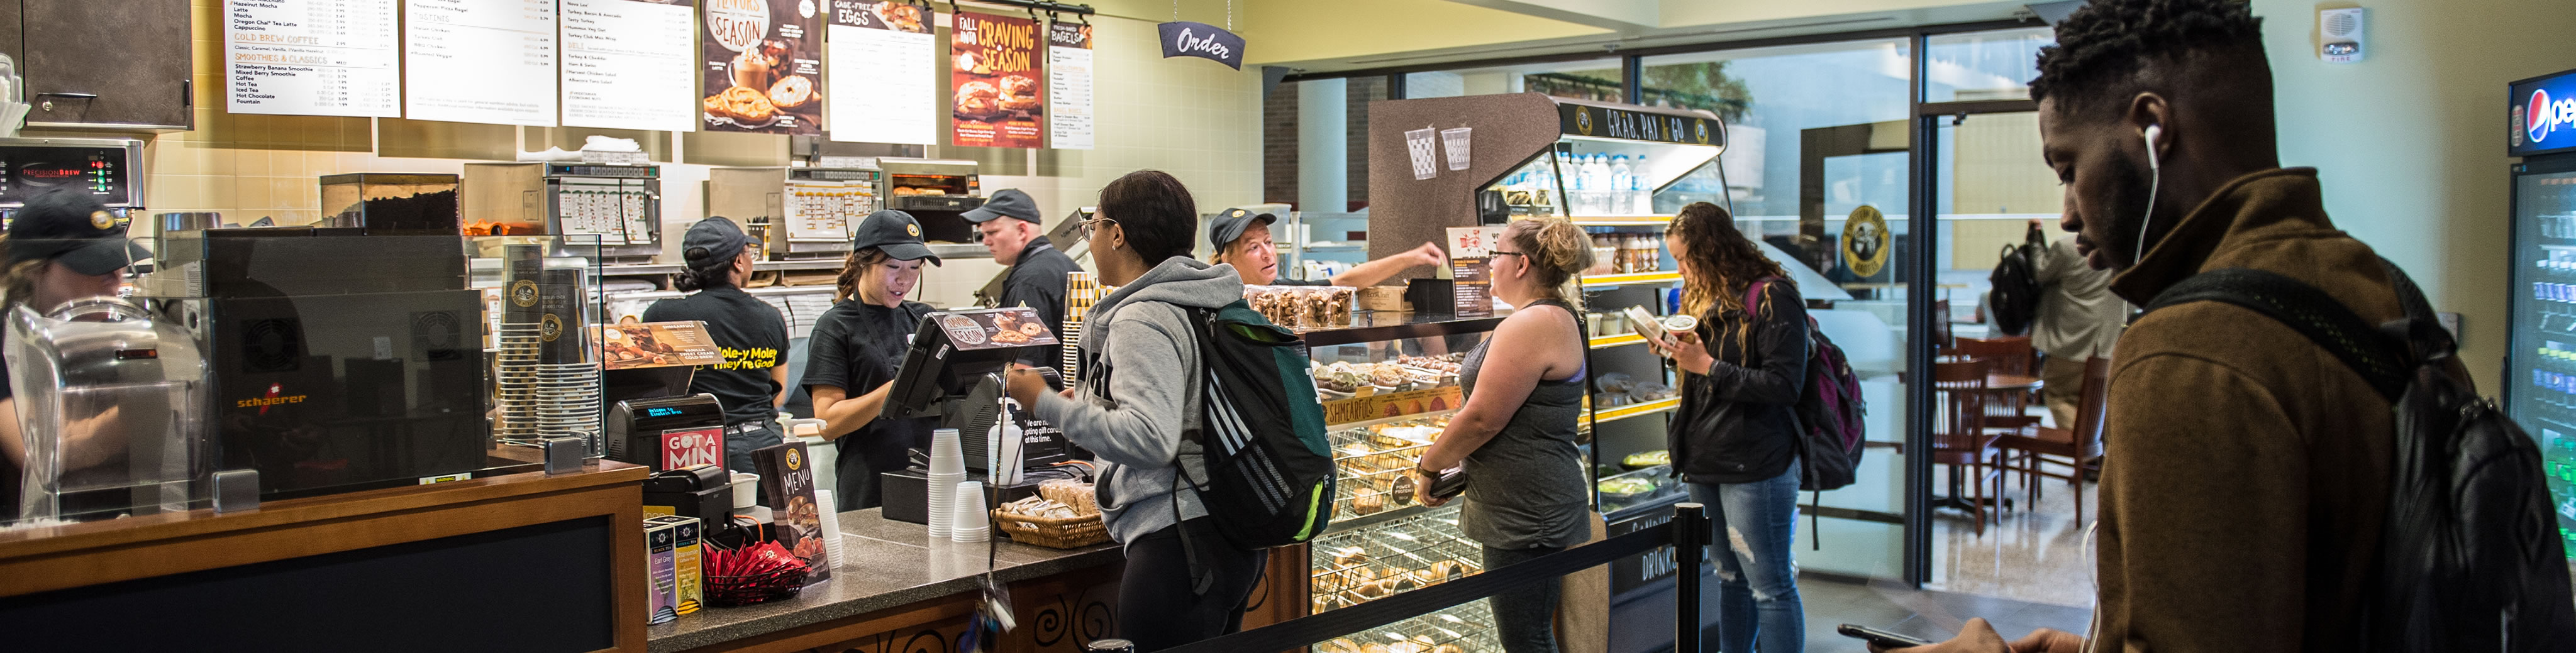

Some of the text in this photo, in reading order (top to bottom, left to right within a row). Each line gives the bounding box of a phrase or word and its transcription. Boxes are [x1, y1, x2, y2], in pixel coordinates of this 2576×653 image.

[839, 9, 869, 25] EGGS
[960, 18, 977, 31] FALL
[716, 17, 760, 47] SEASON
[961, 30, 976, 45] INTO
[979, 19, 1034, 50] CRAVING
[1052, 30, 1079, 44] BAGELS
[287, 36, 319, 45] COFFEE
[1177, 28, 1229, 59] Order
[235, 53, 279, 62] SMOOTHIES
[289, 56, 328, 65] CLASSICS
[982, 48, 1030, 73] SEASON
[2550, 98, 2576, 132] pe
[1640, 114, 1658, 141] PAY
[1662, 116, 1669, 140] &
[1672, 118, 1684, 141] GO
[954, 331, 984, 343] SEASON
[751, 347, 777, 361] Moley
[236, 395, 307, 408] schaerer
[1330, 398, 1374, 422] SHMEARFULS
[669, 434, 716, 450] GOT A
[669, 446, 716, 470] MIN
[784, 469, 809, 495] MENU
